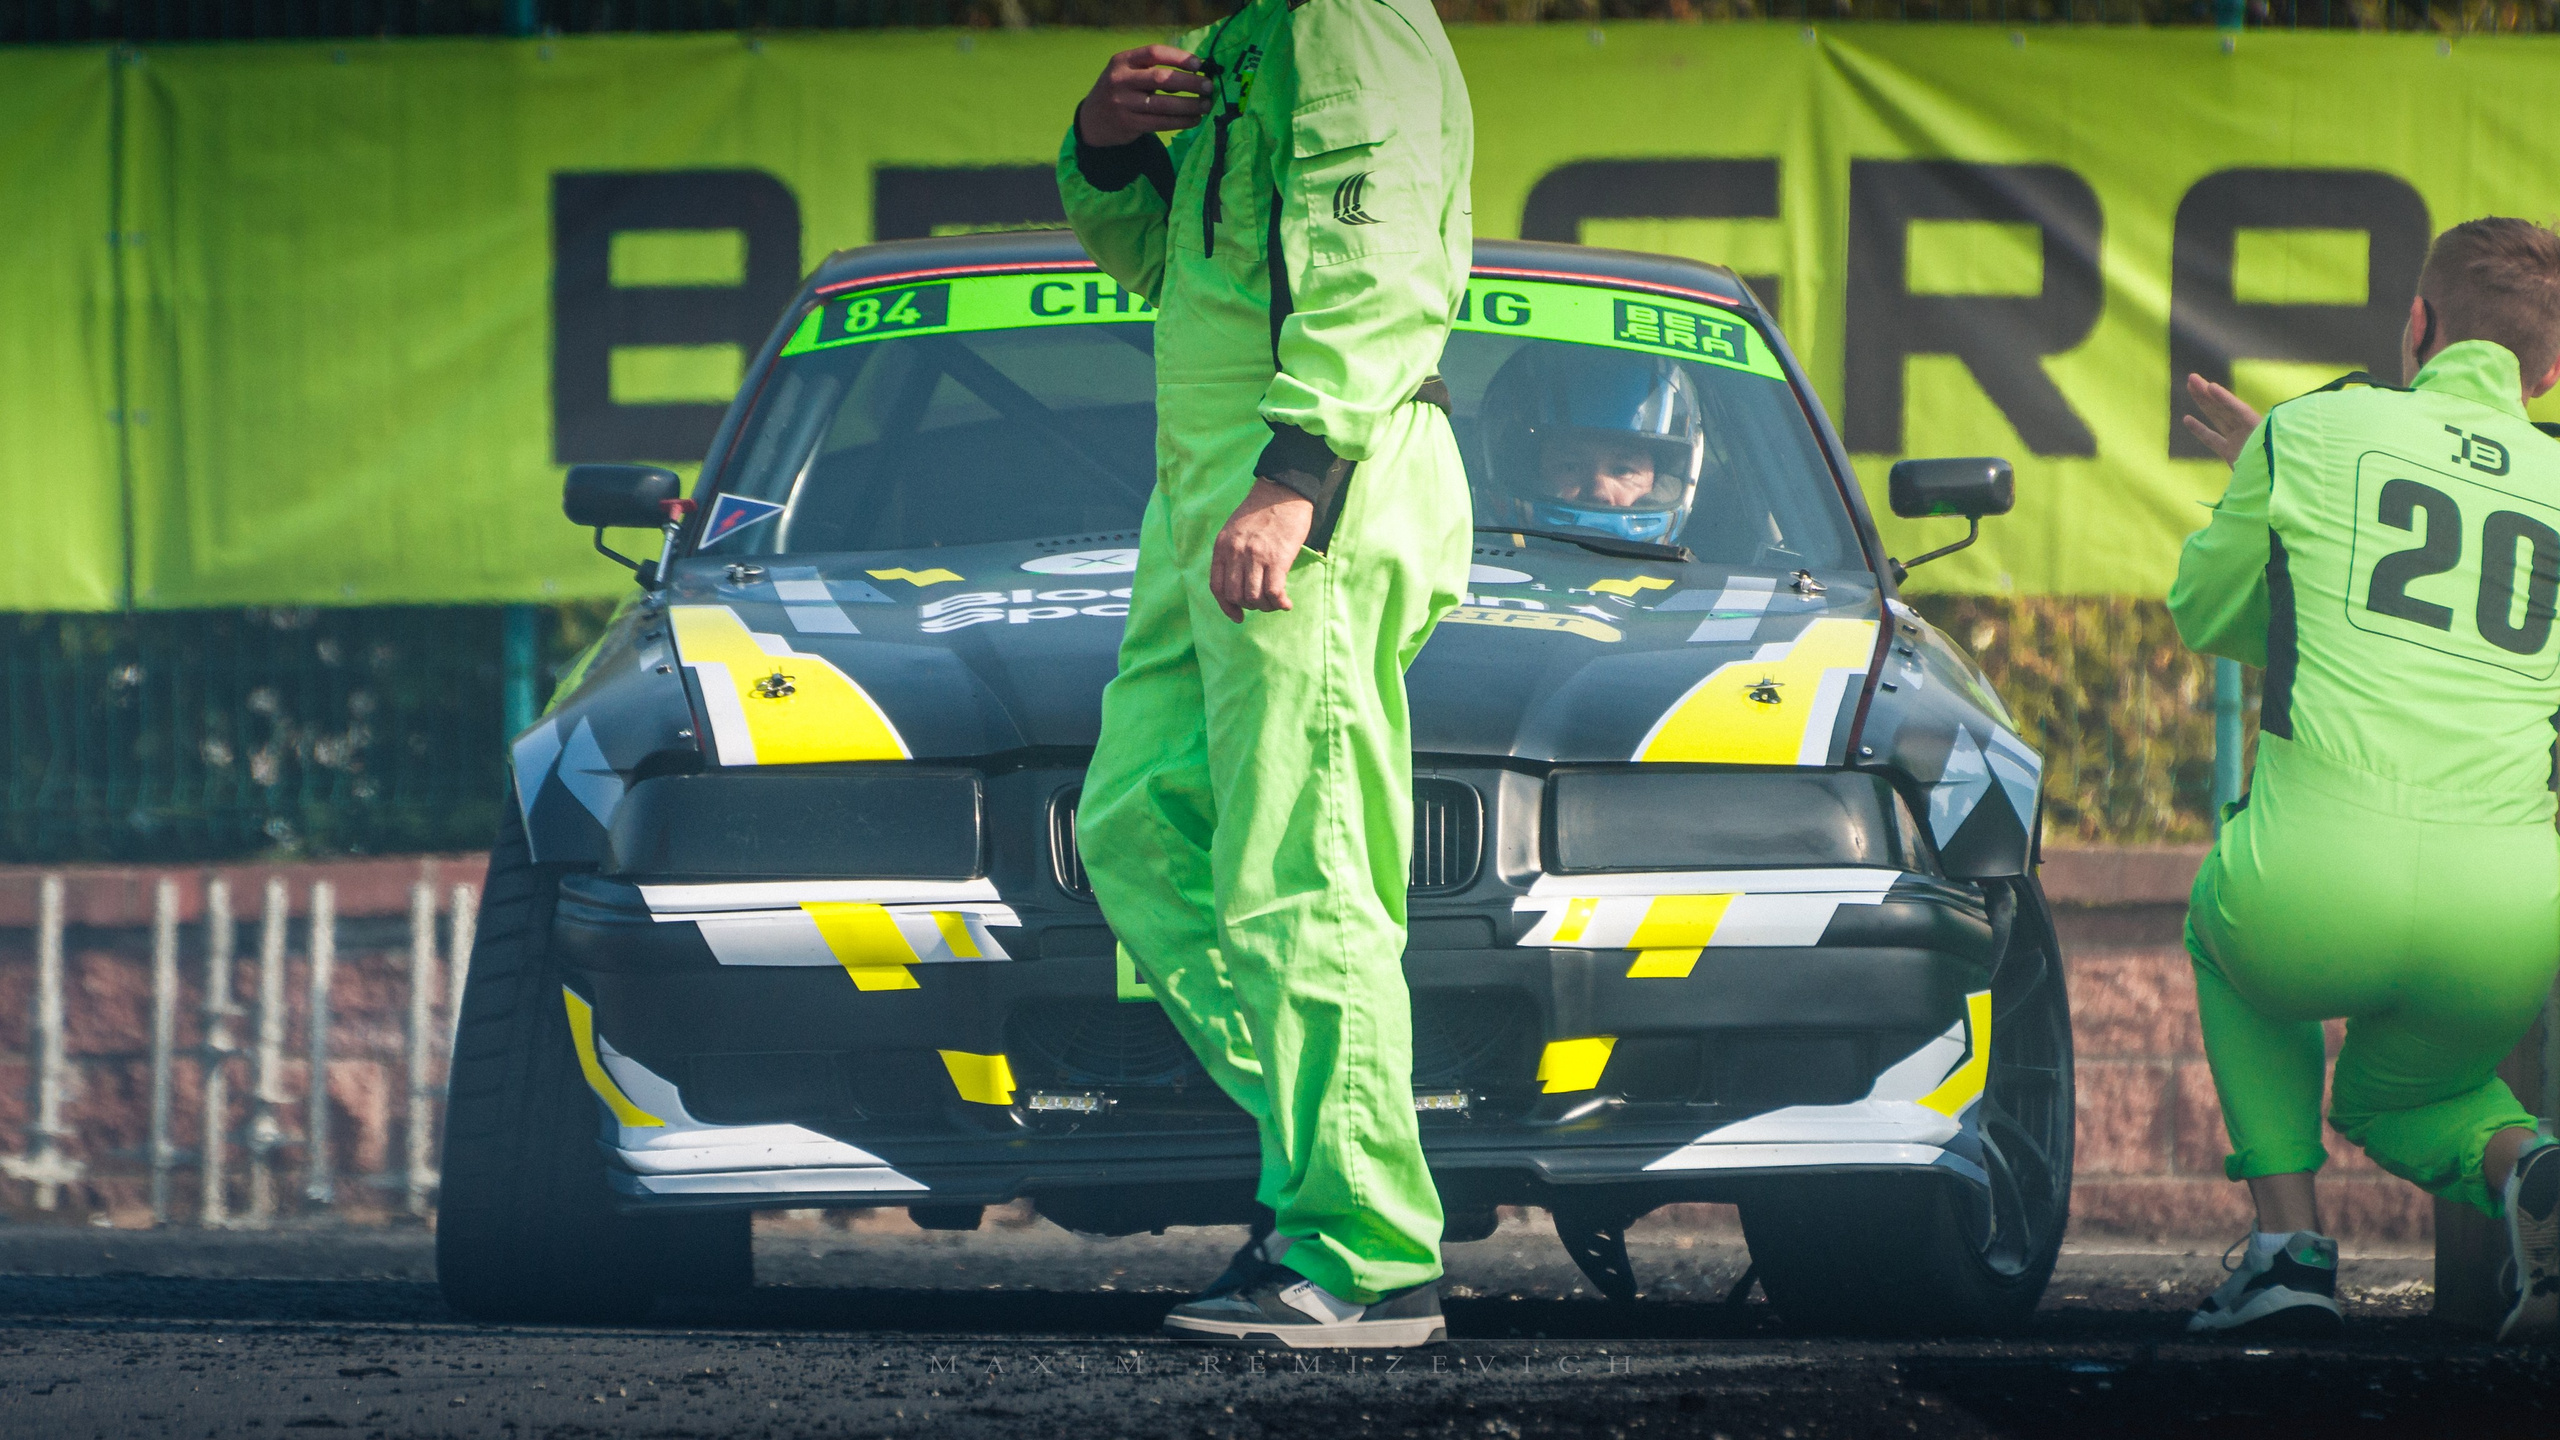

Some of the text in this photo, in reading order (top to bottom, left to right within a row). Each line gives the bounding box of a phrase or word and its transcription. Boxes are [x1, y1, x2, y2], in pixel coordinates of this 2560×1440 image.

[843, 291, 923, 335] 84
[1626, 304, 1733, 338] BET
[1620, 322, 1736, 358] ERA
[2366, 478, 2560, 655] 20
